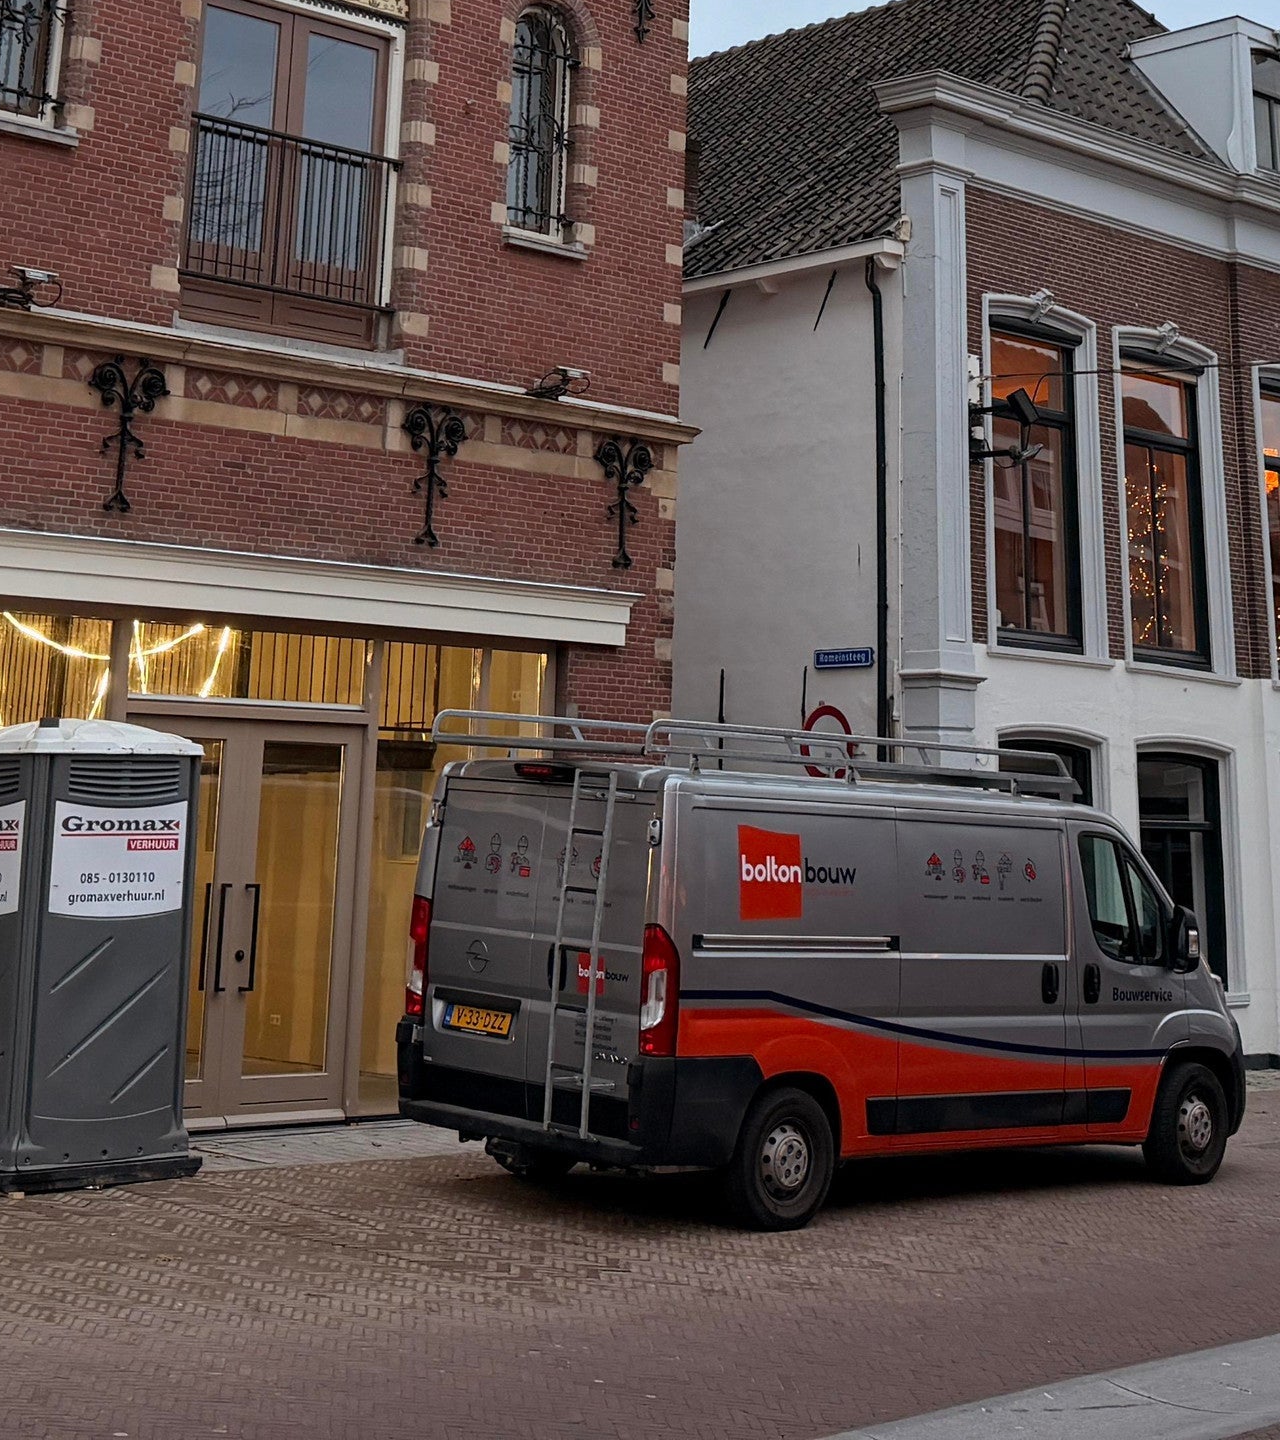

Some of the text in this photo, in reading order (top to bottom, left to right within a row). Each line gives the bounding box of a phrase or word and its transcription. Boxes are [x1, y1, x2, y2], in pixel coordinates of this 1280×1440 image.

[819, 652, 866, 663] Romeinsteeg
[61, 815, 177, 832] Gromax
[129, 839, 177, 850] VERHUUR
[740, 854, 857, 885] bolton bouw
[80, 872, 100, 884] 085
[108, 872, 155, 883] 0130110
[68, 889, 165, 906] gromaxverhuur.nl
[605, 968, 629, 983] bouw
[1112, 987, 1173, 1002] Bouwservice
[456, 1008, 507, 1031] V-33-DZZ
